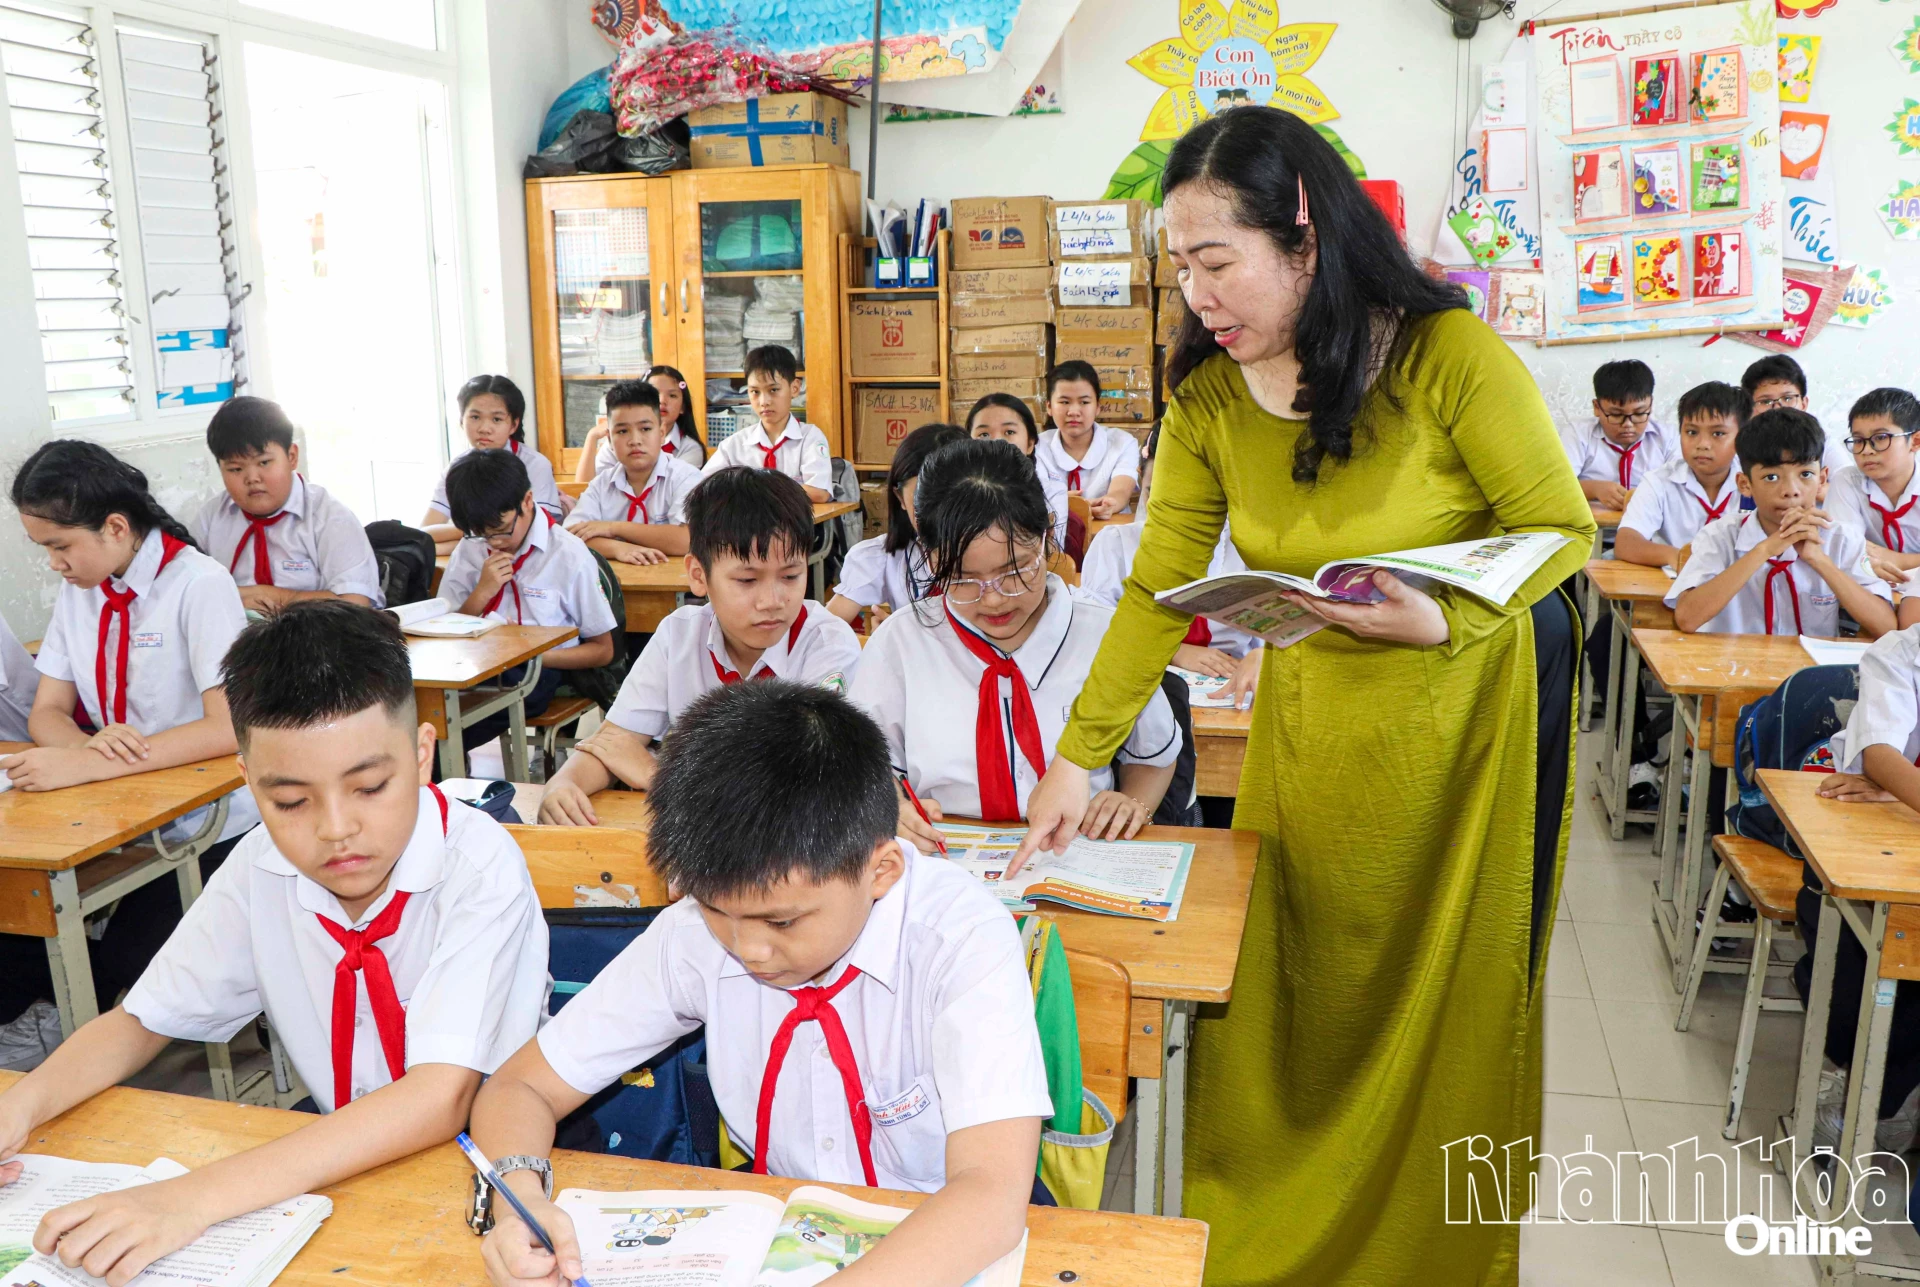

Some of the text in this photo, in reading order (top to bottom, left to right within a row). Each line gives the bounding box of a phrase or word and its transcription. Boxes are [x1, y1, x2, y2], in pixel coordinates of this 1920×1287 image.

[1664, 25, 1683, 41] CÔ
[1214, 46, 1254, 64] Con
[1293, 41, 1309, 51] nay
[1199, 66, 1271, 87] Biết Ơn
[1188, 90, 1196, 109] Cha
[1285, 89, 1304, 101] mọi
[1305, 94, 1323, 108] thứ
[856, 304, 880, 316] Sách
[1096, 313, 1118, 328] Sách
[866, 390, 895, 410] SÁCH
[902, 395, 917, 410] L3
[888, 420, 906, 438] GD
[897, 1112, 911, 1120] TÙNG
